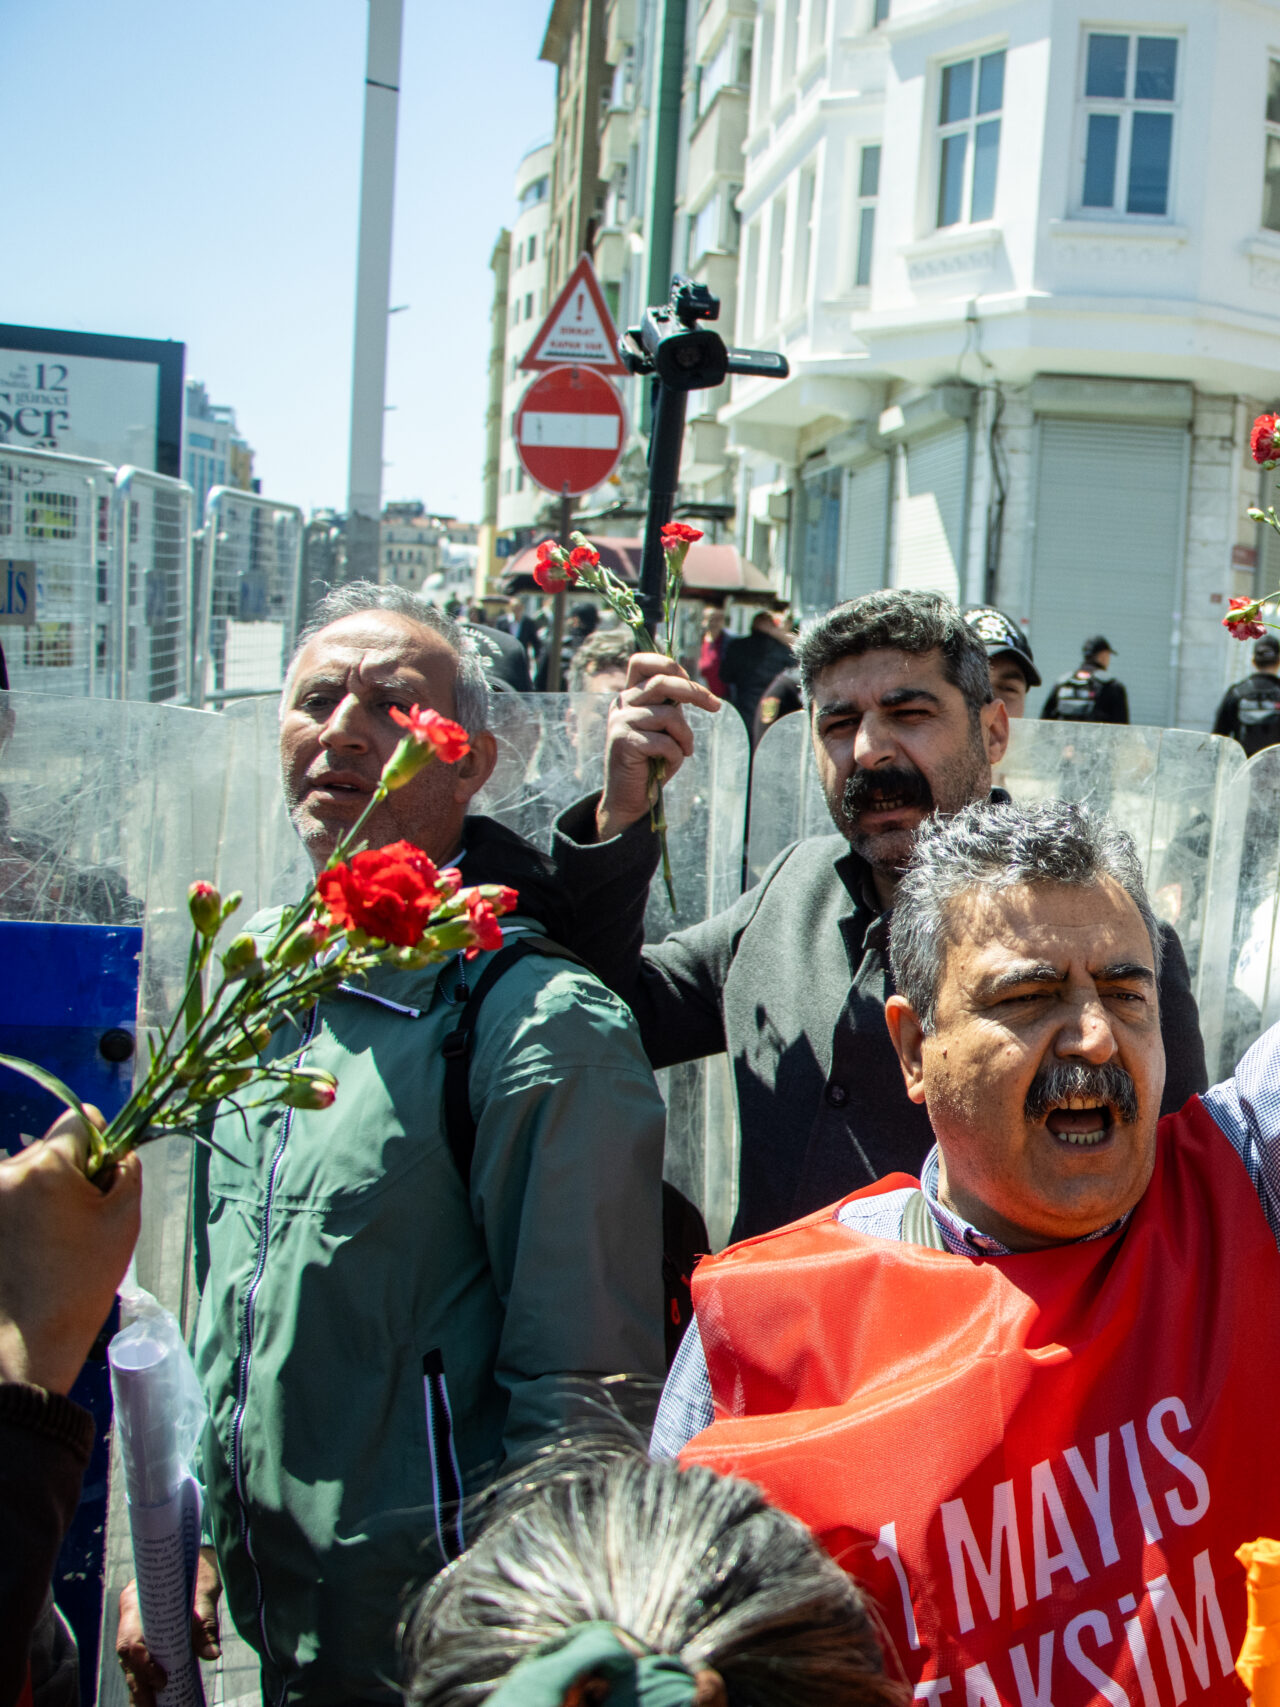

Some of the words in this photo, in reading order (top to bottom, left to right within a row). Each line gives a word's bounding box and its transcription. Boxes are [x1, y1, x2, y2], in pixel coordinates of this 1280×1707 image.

[37, 363, 68, 391] 12
[0, 560, 27, 614] İS
[872, 1521, 921, 1650] 1
[940, 1396, 1211, 1635] MAYIS
